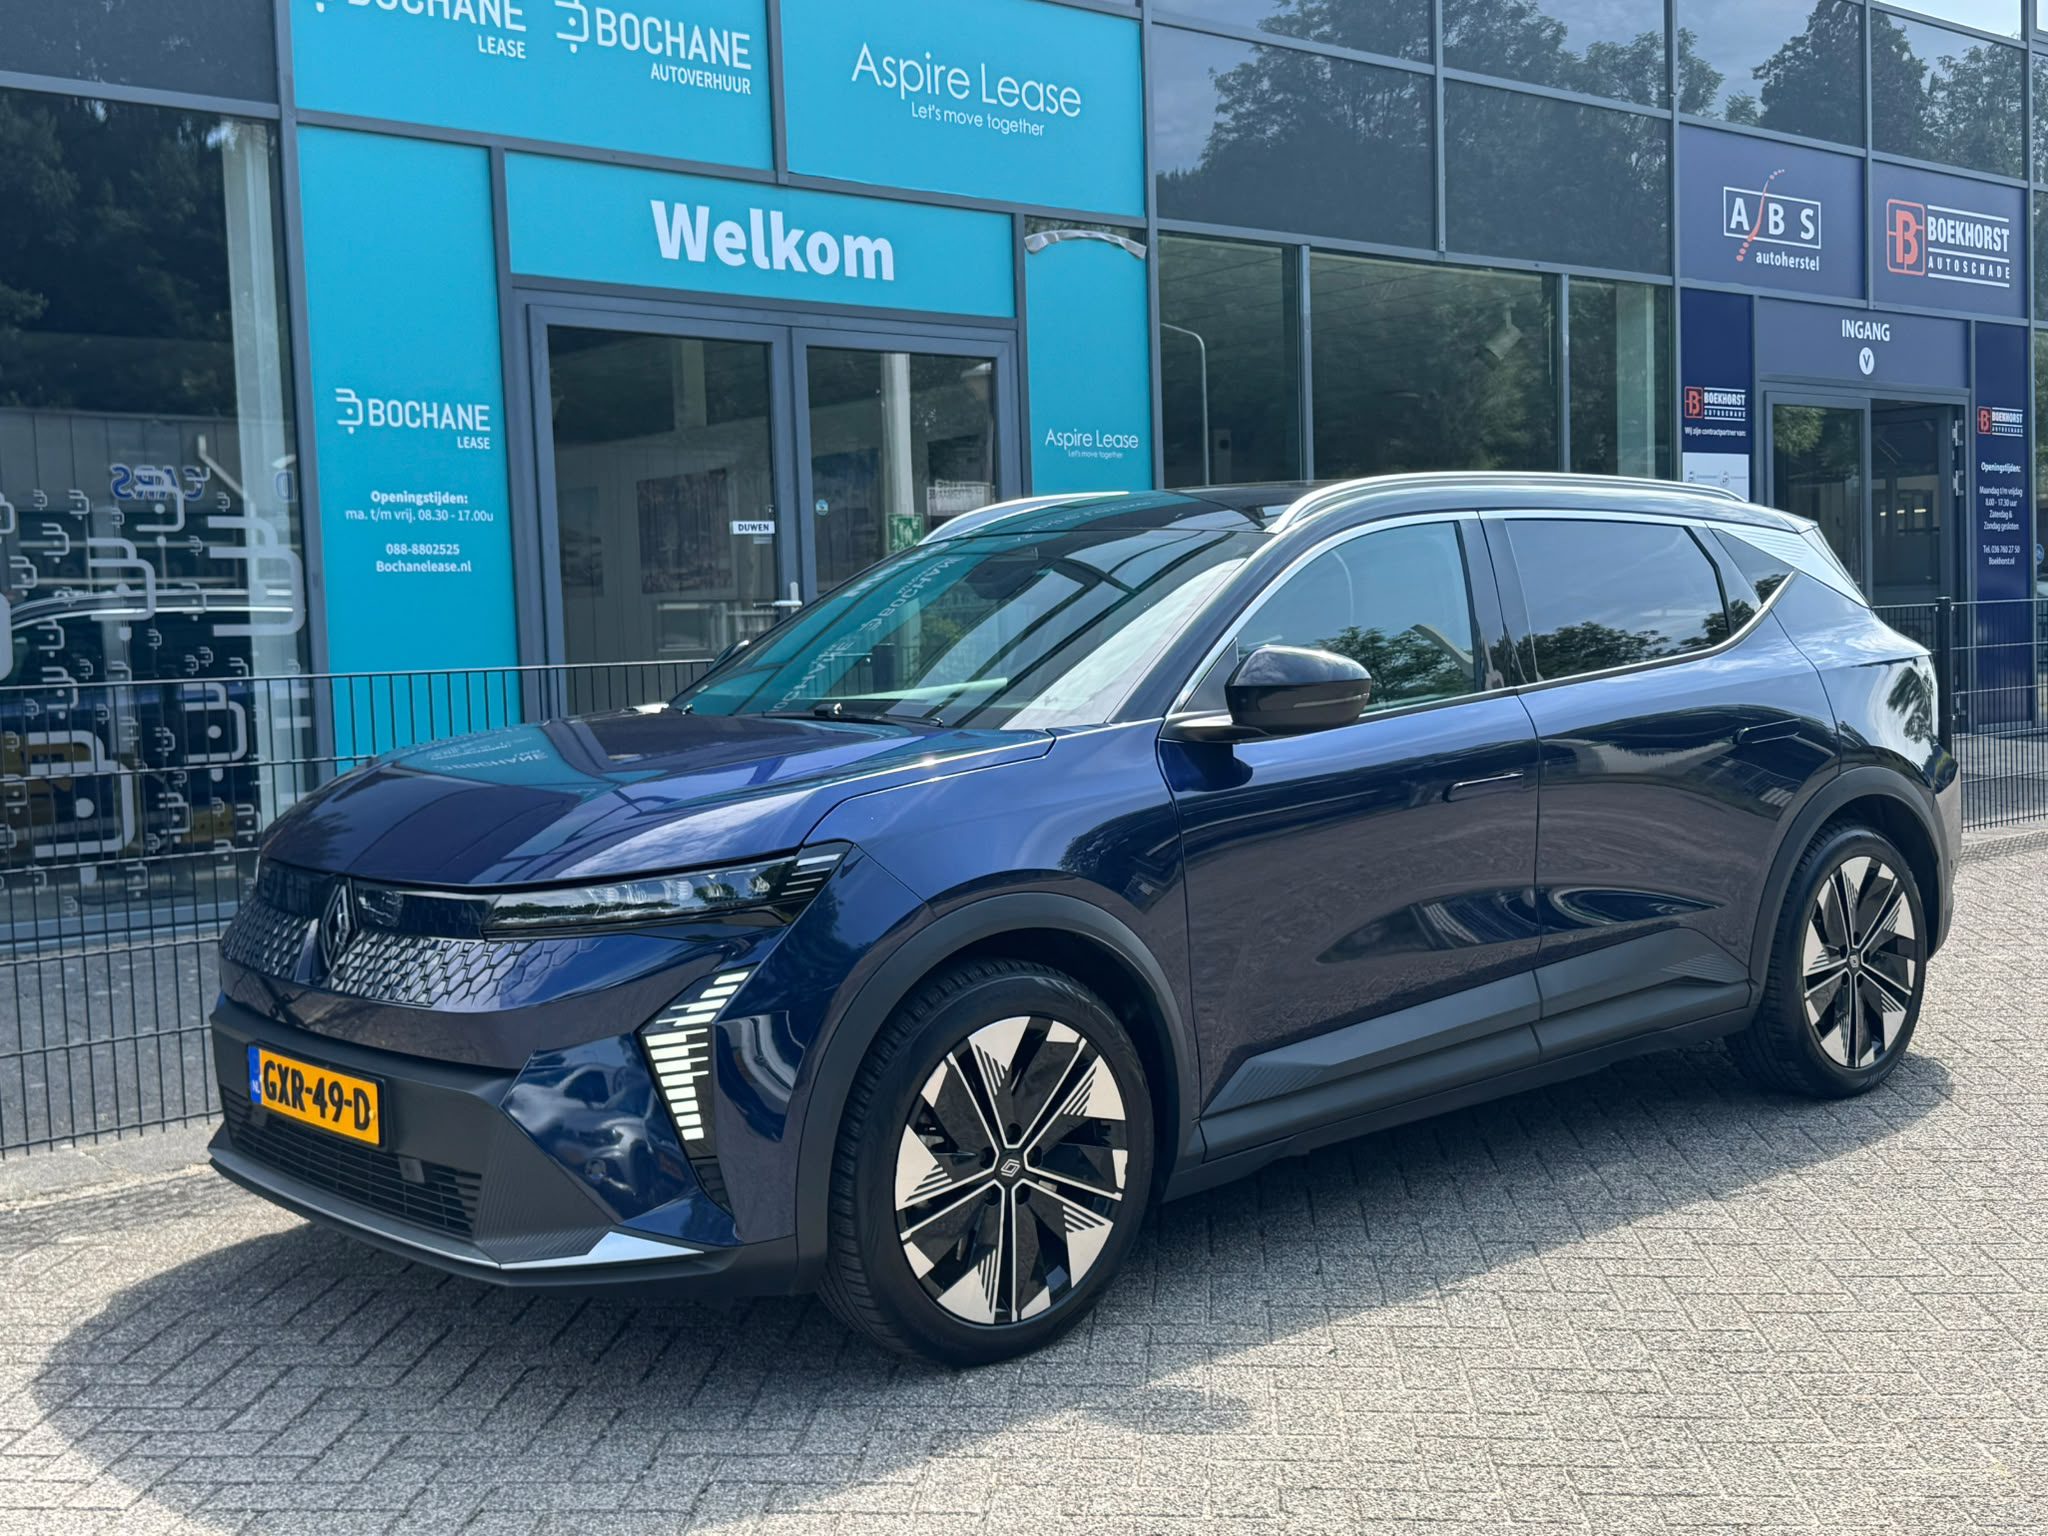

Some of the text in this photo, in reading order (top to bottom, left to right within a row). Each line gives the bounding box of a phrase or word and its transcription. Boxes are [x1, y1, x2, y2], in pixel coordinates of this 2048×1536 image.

[478, 36, 527, 60] LEASE
[596, 6, 752, 70] BOCHANE
[650, 63, 752, 95] AUTOVERHUUR
[851, 42, 1082, 118] Aspire Lease
[911, 102, 1045, 137] Let's move together
[650, 199, 895, 282] Welkom
[1927, 216, 2010, 253] BOEKHORST
[1755, 250, 1820, 272] autoherstel
[1927, 255, 2011, 280] AUTOSCHADE
[1841, 319, 1891, 342] INGANG
[1704, 392, 1745, 405] BOEKHORST
[368, 398, 491, 432] BOCHANE
[457, 436, 491, 450] LEASE
[1044, 427, 1139, 451] Aspire Lease
[371, 491, 468, 506] Openingstijden:
[345, 510, 368, 521] ma.
[370, 508, 392, 522] t/m
[395, 509, 415, 523] vrij.
[418, 510, 449, 521] 08.30
[458, 510, 494, 522] 17.00u
[738, 523, 770, 531] DUWEN
[386, 543, 460, 556] 088-8802525
[376, 561, 472, 573] Bochanelease.nl
[263, 1059, 371, 1132] GXR-49-D
